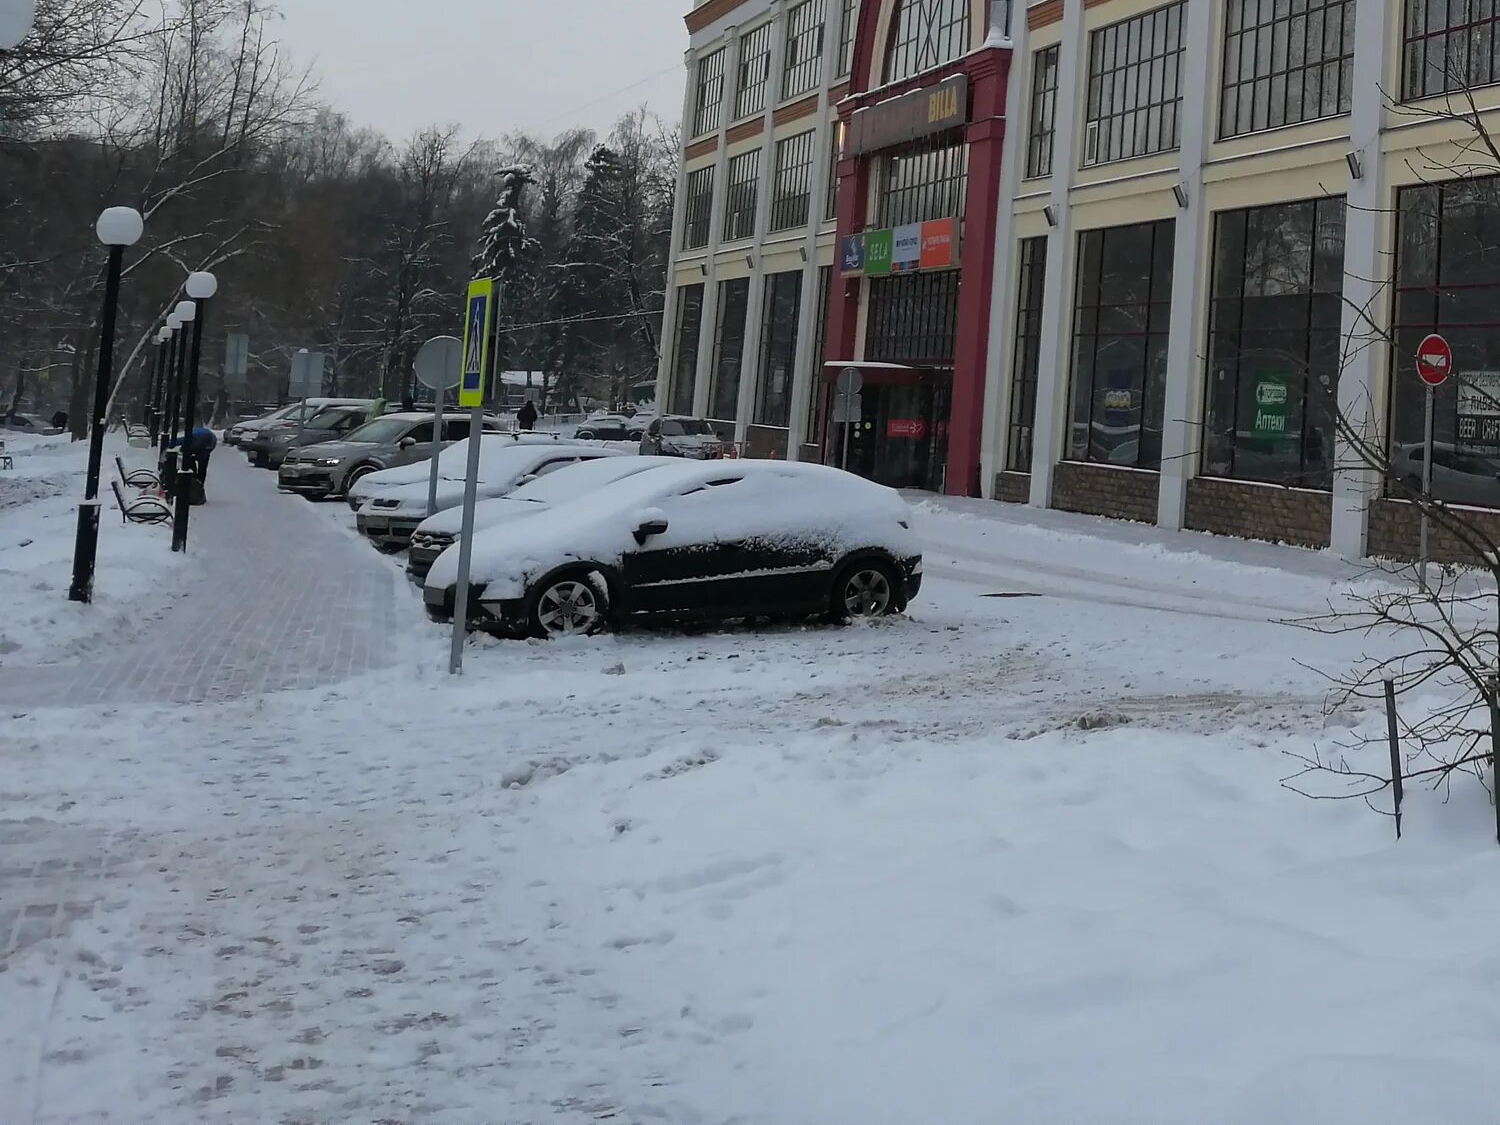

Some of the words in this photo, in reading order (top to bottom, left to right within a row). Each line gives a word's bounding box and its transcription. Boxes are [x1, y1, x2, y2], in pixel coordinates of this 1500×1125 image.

[928, 85, 958, 124] BILLA
[869, 242, 888, 262] SELA
[1255, 408, 1286, 432] Аптеки
[1459, 417, 1477, 438] BEER
